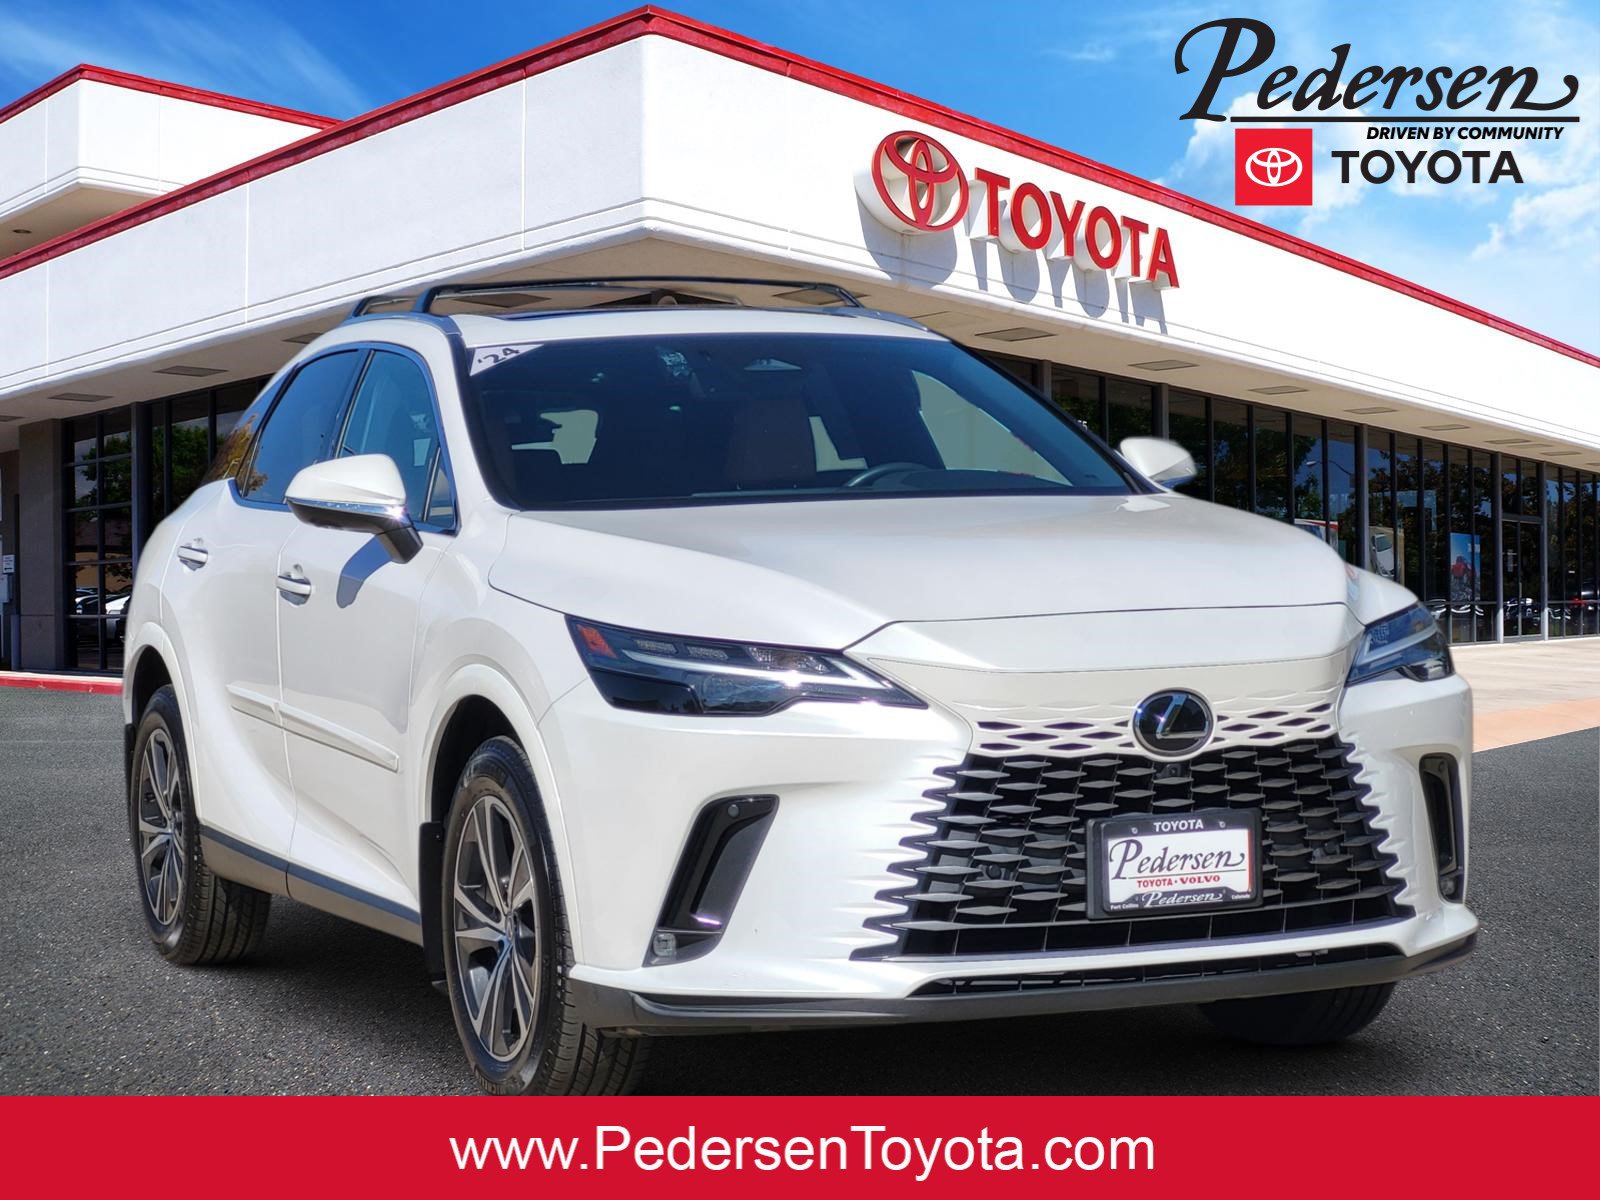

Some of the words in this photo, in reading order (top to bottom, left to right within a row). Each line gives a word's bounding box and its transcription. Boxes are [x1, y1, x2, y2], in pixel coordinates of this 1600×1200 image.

[974, 167, 1180, 289] TOYOTA
[1153, 819, 1204, 832] TOYOTA
[1109, 838, 1246, 881] Pedersen
[1137, 878, 1173, 888] TOYOTA
[1180, 875, 1221, 885] VOLVO
[1141, 890, 1223, 908] Pedersen
